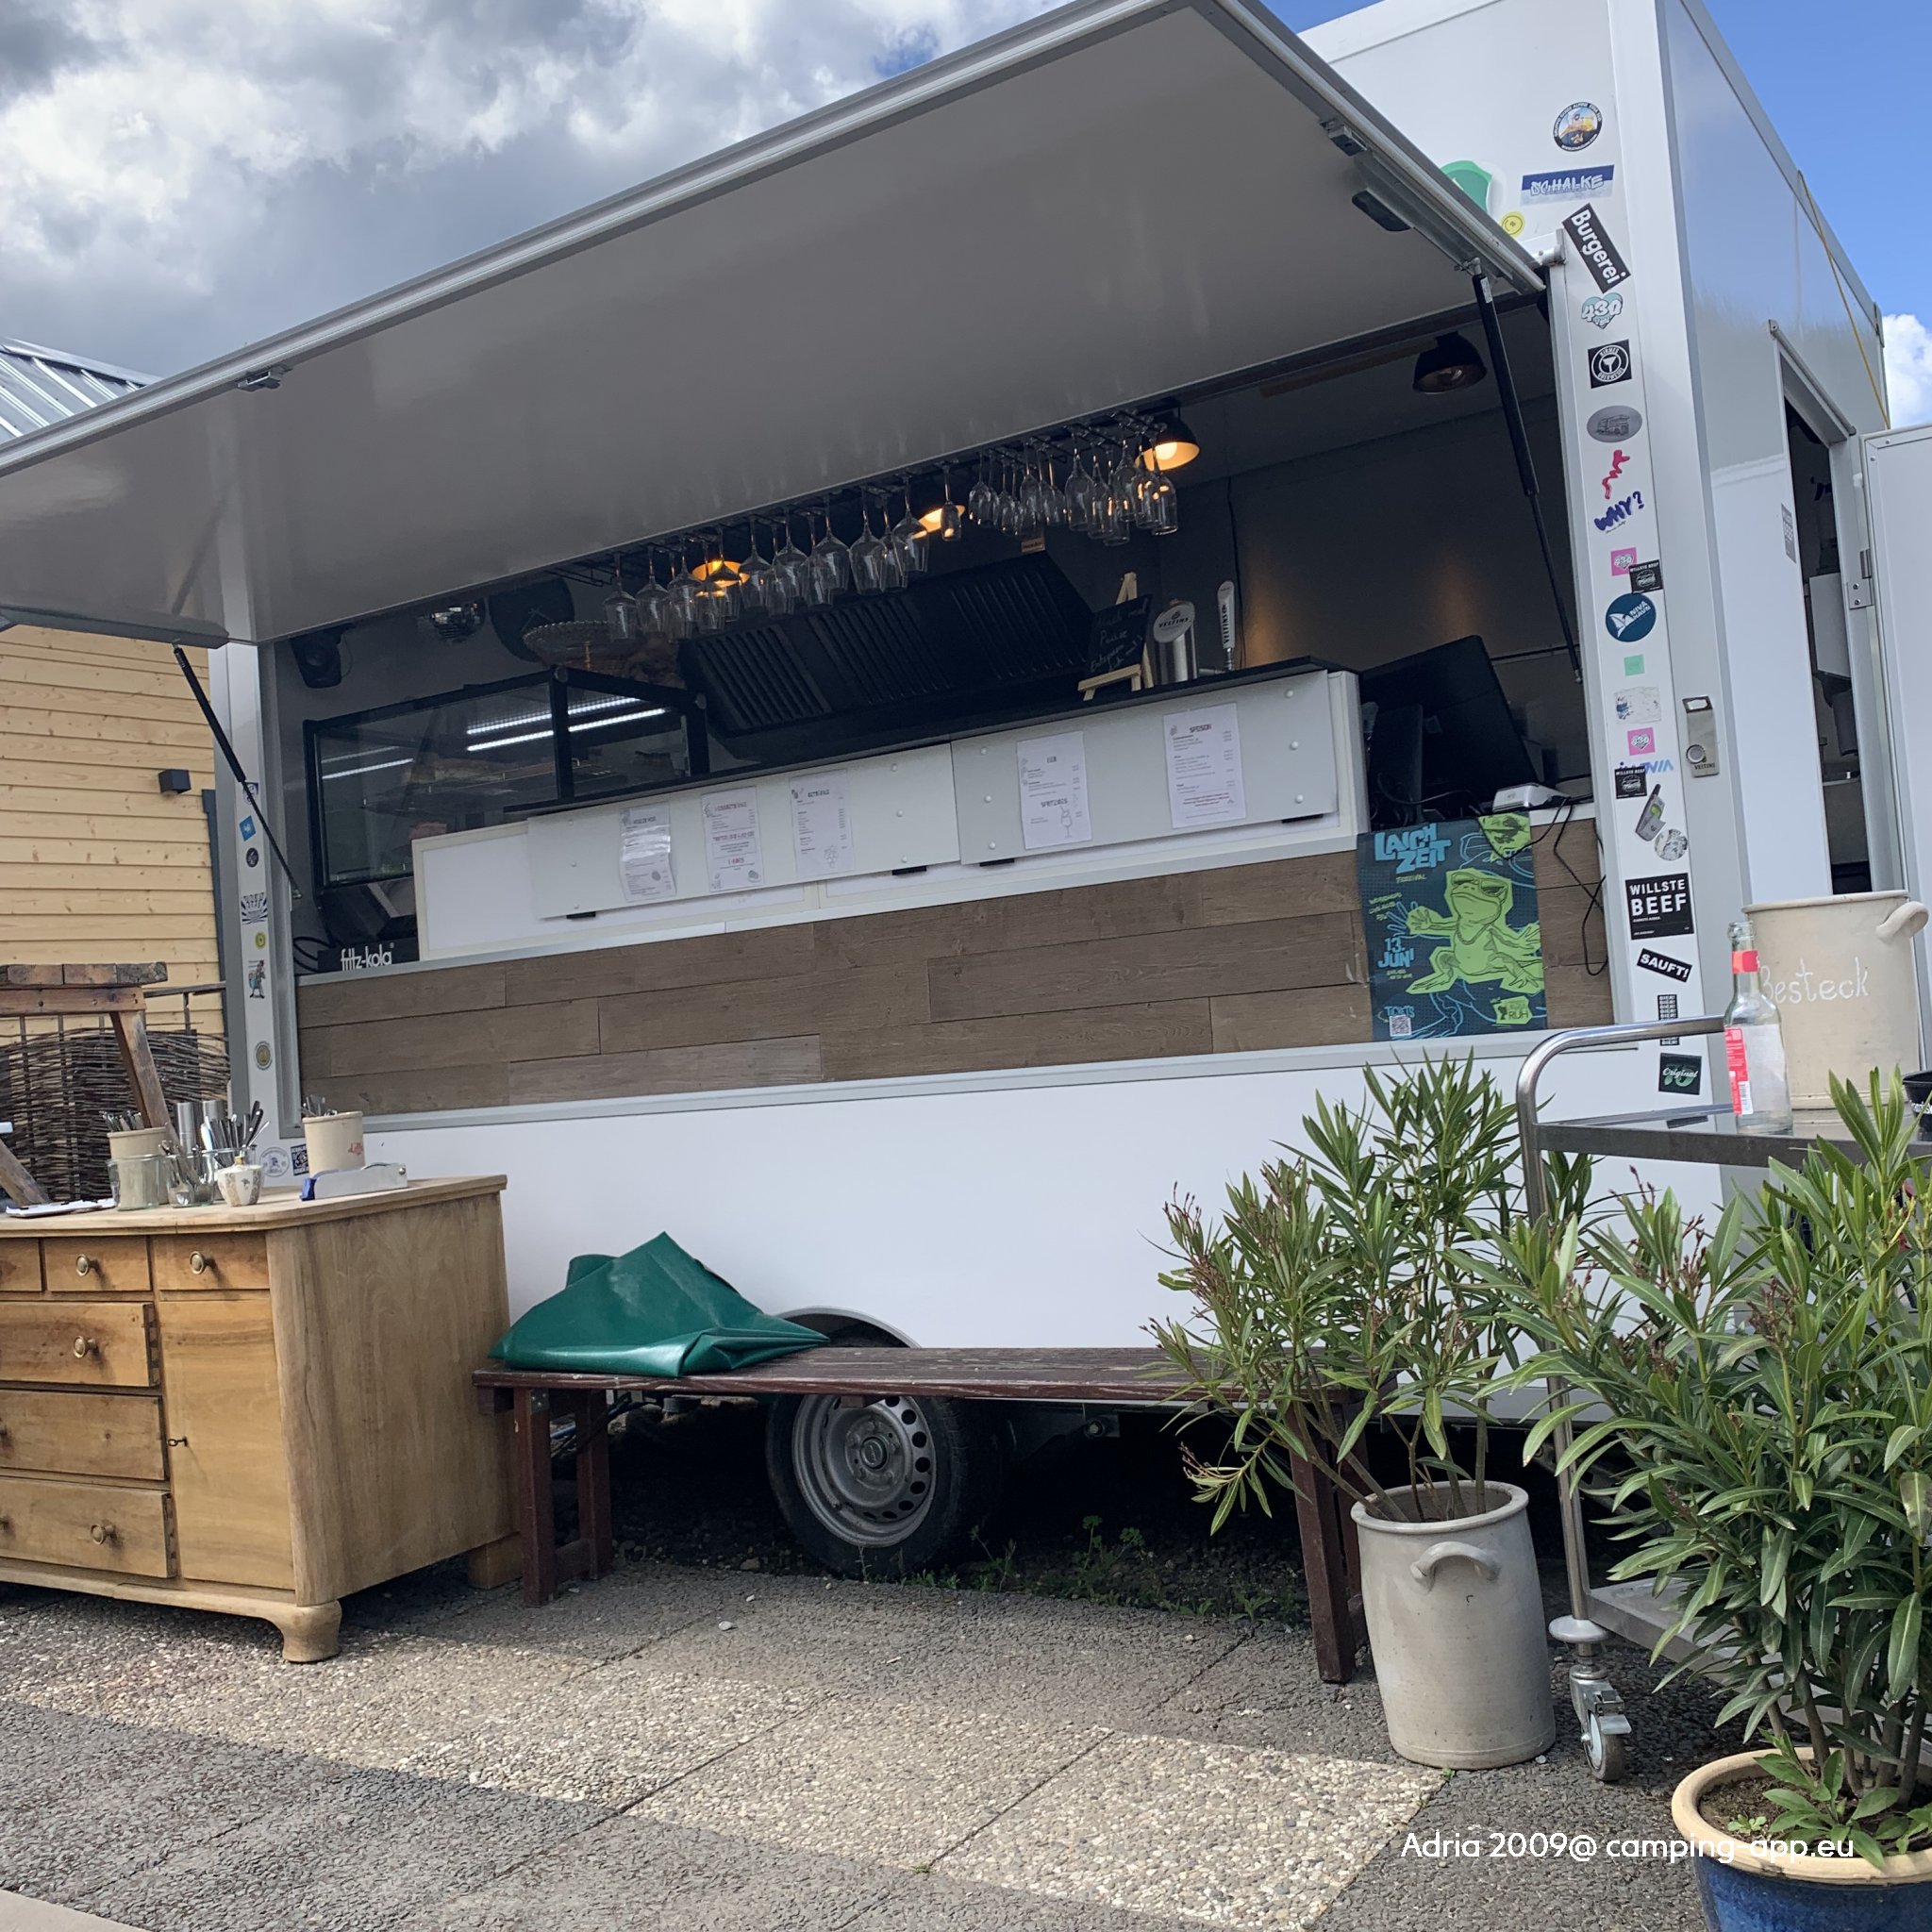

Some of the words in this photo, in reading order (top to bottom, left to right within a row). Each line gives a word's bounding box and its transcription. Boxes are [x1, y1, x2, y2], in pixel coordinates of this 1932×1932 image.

[1530, 175, 1604, 196] SCHALKE
[1571, 208, 1627, 284] Burgerei
[1594, 491, 1644, 530] WHY?
[1374, 823, 1438, 861] LAICH
[1396, 839, 1452, 874] ZEIT
[1629, 879, 1686, 895] WILLSTE
[1630, 892, 1687, 917] BEEF
[1378, 947, 1414, 968] JUNI
[1384, 937, 1406, 953] 13.
[1640, 953, 1689, 979] SAUFT!
[1662, 1067, 1699, 1079] Original
